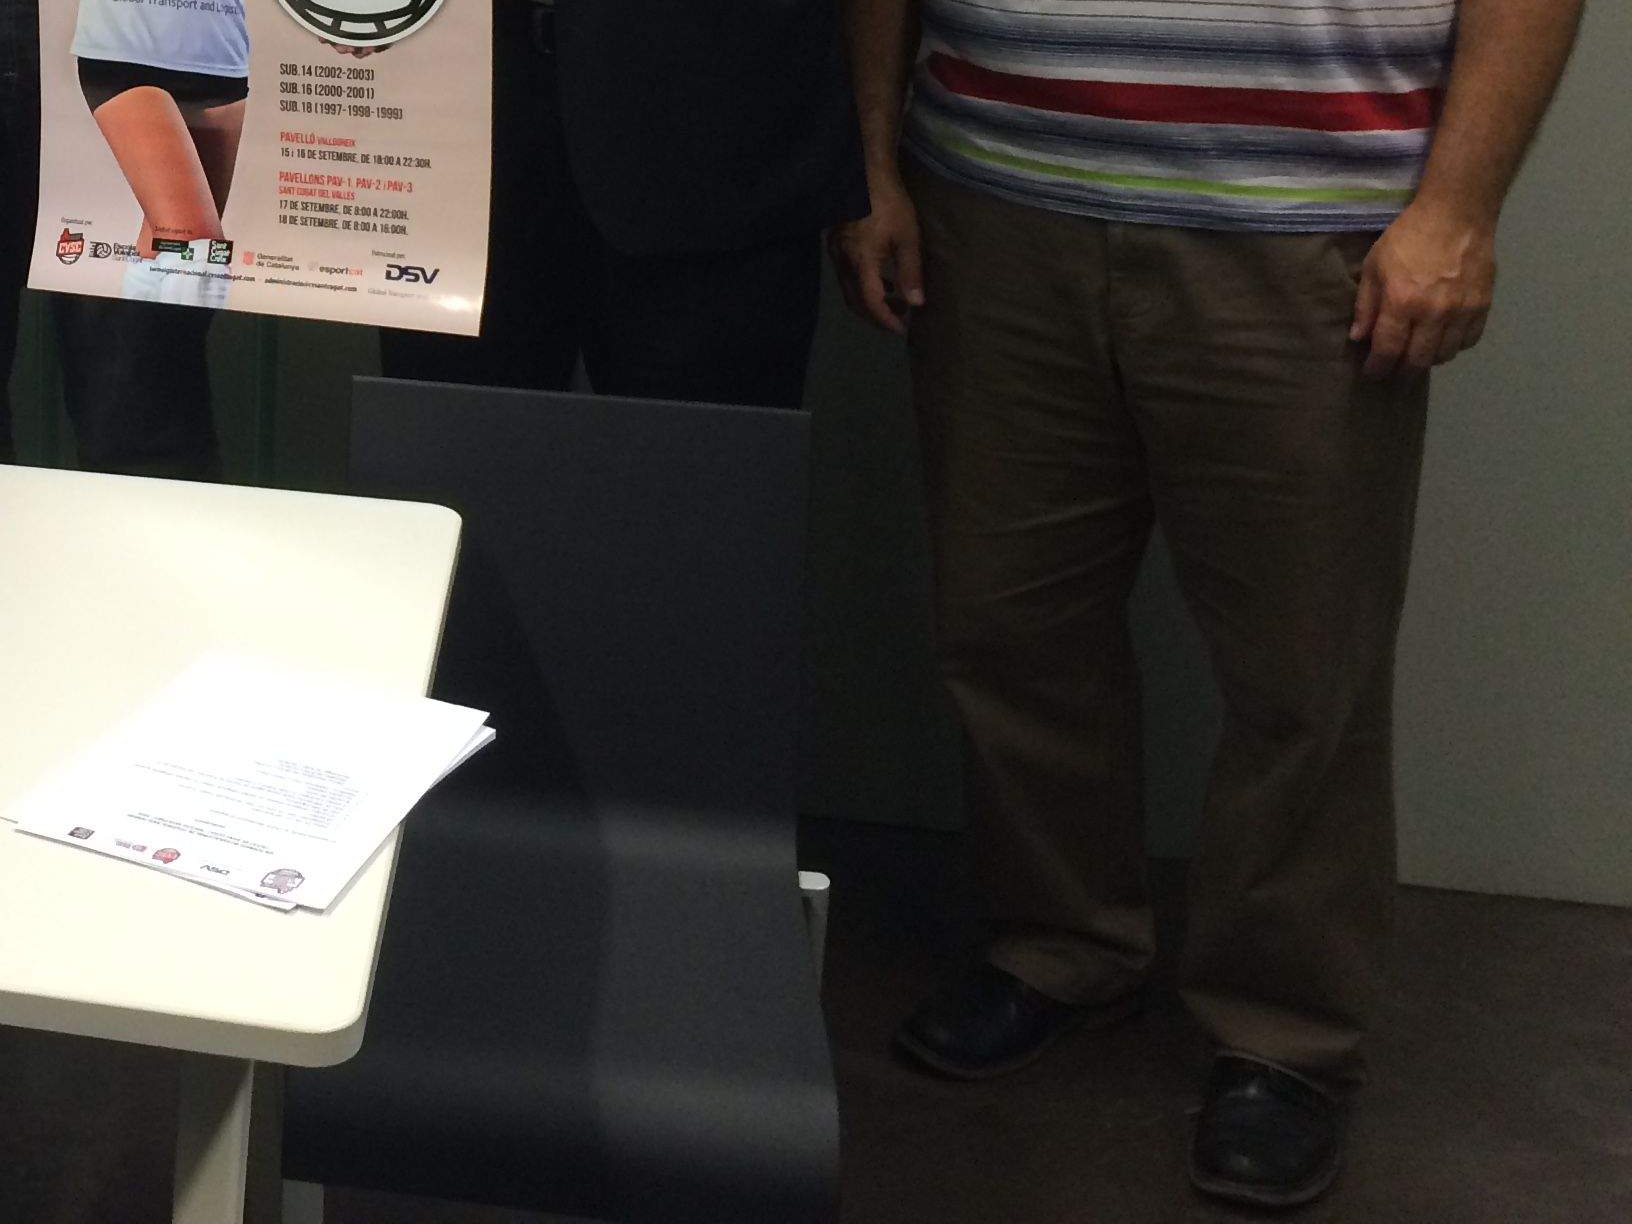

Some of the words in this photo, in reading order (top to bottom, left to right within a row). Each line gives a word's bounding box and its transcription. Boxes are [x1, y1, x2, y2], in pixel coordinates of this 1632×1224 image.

[279, 62, 299, 75] SUB.
[301, 64, 312, 76] 14
[314, 65, 374, 82] (2002-2003)
[279, 80, 299, 94] SUB.
[301, 82, 312, 95] 16
[314, 83, 374, 100] (2000-2001)
[279, 98, 299, 112] SUB.
[301, 100, 312, 113] 18
[307, 149, 316, 159] DE
[360, 153, 369, 163] DE
[395, 156, 400, 166] A
[289, 200, 297, 210] DE
[343, 205, 352, 215] DE
[373, 207, 377, 217] A
[288, 215, 297, 225] DE
[342, 219, 351, 230] DE
[371, 222, 377, 232] A
[385, 264, 440, 284] DSV
